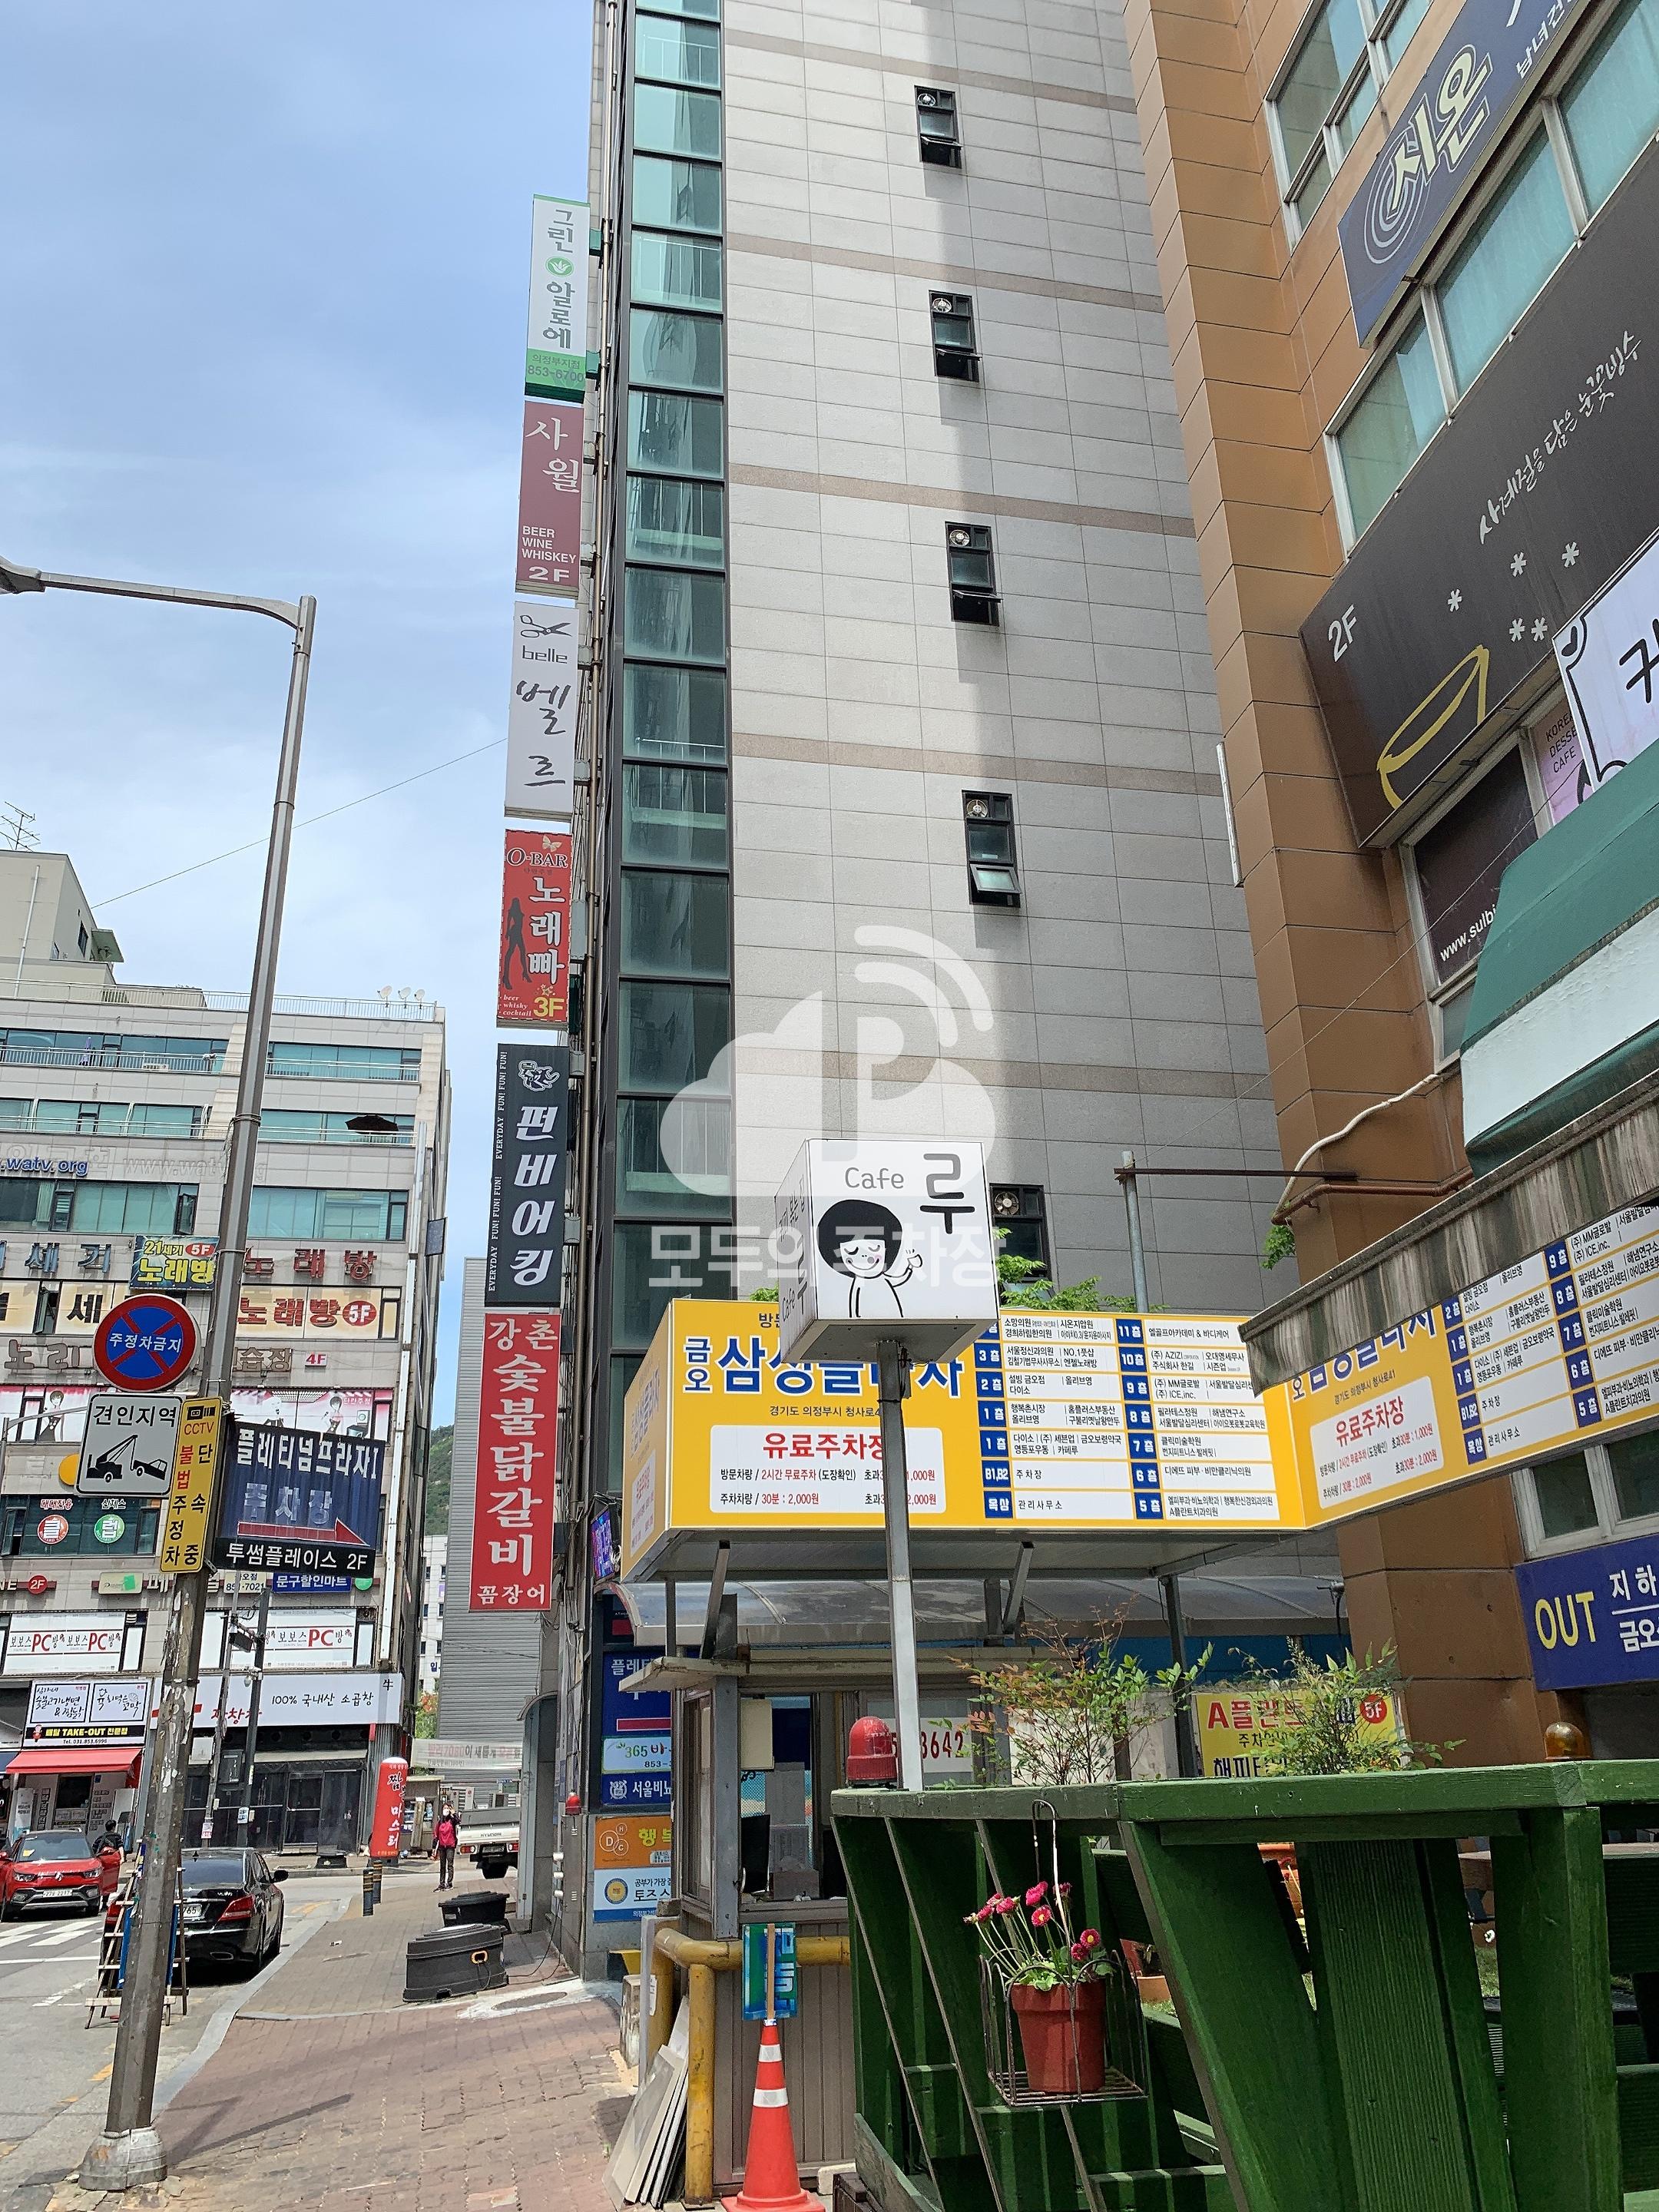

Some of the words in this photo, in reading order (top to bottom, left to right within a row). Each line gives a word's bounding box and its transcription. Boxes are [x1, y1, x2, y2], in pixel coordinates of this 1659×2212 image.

[546, 209, 575, 254] 그린
[542, 280, 576, 350] 알로에
[531, 353, 581, 371] 의정부지점
[528, 365, 584, 383] 853-6700
[525, 416, 581, 494] 사월
[522, 525, 555, 539] BEER
[522, 537, 553, 551] WINE
[522, 549, 577, 565] WHISKEY
[528, 565, 570, 583] 2F
[1328, 604, 1358, 662] 2F
[522, 644, 568, 664] belle
[1553, 745, 1577, 774] CAFE
[506, 847, 569, 869] O-BAR
[527, 875, 566, 985] 노래빠
[502, 1002, 528, 1010] whisky
[502, 1009, 532, 1018] cocktail
[532, 995, 565, 1018] 3F
[496, 1116, 505, 1161] EVERYDAY
[0, 1155, 89, 1177] .watv.org
[510, 1105, 559, 1287] 펀비어킹
[845, 1166, 905, 1190] Cafe
[919, 1152, 975, 1235] 루
[144, 1240, 184, 1257] 21세기
[190, 1243, 211, 1256] 5F
[137, 1257, 216, 1283] 노래방
[243, 1247, 377, 1280] 노래방
[488, 1245, 498, 1292] EVERYDAY
[237, 1297, 341, 1327] 노래방
[348, 1303, 372, 1323] 5F
[1005, 1318, 1031, 1329] 소망의원
[1061, 1319, 1094, 1330] 시온지압원
[109, 1333, 183, 1353] 주정차금지
[487, 1318, 558, 1351] 강촌
[305, 1353, 326, 1365] 4F
[1007, 1346, 1054, 1356] 서울정신과의원
[684, 1336, 714, 1394] 금오
[1064, 1359, 1097, 1368] 엔젤노래방
[1153, 1361, 1179, 1370] 주식회사
[1008, 1375, 1022, 1385] 설빙
[1024, 1375, 1045, 1385] 금오점
[1065, 1376, 1092, 1386] 올리브영
[1009, 1386, 1031, 1395] 다이소
[93, 1404, 177, 1429] 견인지역
[770, 1405, 800, 1416] 경기도
[803, 1405, 843, 1418] 의정부시
[1011, 1404, 1045, 1413] 행복촌시장
[184, 1422, 214, 1435] CCTV
[1012, 1415, 1040, 1425] 올리브영
[1159, 1418, 1210, 1427] 서울발달심리센터
[1336, 1396, 1404, 1447] 유료주차장
[1014, 1434, 1035, 1442] 다이소
[1081, 1435, 1121, 1445] 금오보령약국
[1015, 1445, 1048, 1455] 영등포우동
[486, 1353, 547, 1578] 숯불닭갈비
[1187, 1466, 1200, 1475] 피부
[720, 1468, 753, 1482] 방문차량
[761, 1468, 783, 1482] 2시간
[784, 1468, 816, 1482] 무료주차
[720, 1493, 753, 1505] 주차차량
[761, 1493, 780, 1506] 30분
[788, 1493, 820, 1506] 2,000원
[1018, 1500, 1063, 1510] 관리사무소
[227, 1542, 336, 1570] 투썸플레이스
[346, 1553, 368, 1571] 2F
[30, 1580, 45, 1590] 2F
[276, 1575, 348, 1588] 문구할인마트
[1609, 1564, 1657, 1601] 지하
[477, 1584, 545, 1606] 꼼장어
[1535, 1590, 1597, 1651] OUT
[31, 1634, 52, 1652] PC
[88, 1632, 108, 1651] PC
[308, 1628, 334, 1647] PC
[1619, 1618, 1659, 1654] 금오
[382, 1679, 394, 1691] 牛
[271, 1694, 297, 1705] 100%
[302, 1693, 335, 1707] 국내산
[340, 1691, 374, 1707] 소곱창
[62, 1728, 106, 1737] TAKE-OUT
[625, 1744, 648, 1758] 365
[634, 1889, 657, 1902] 토즈
